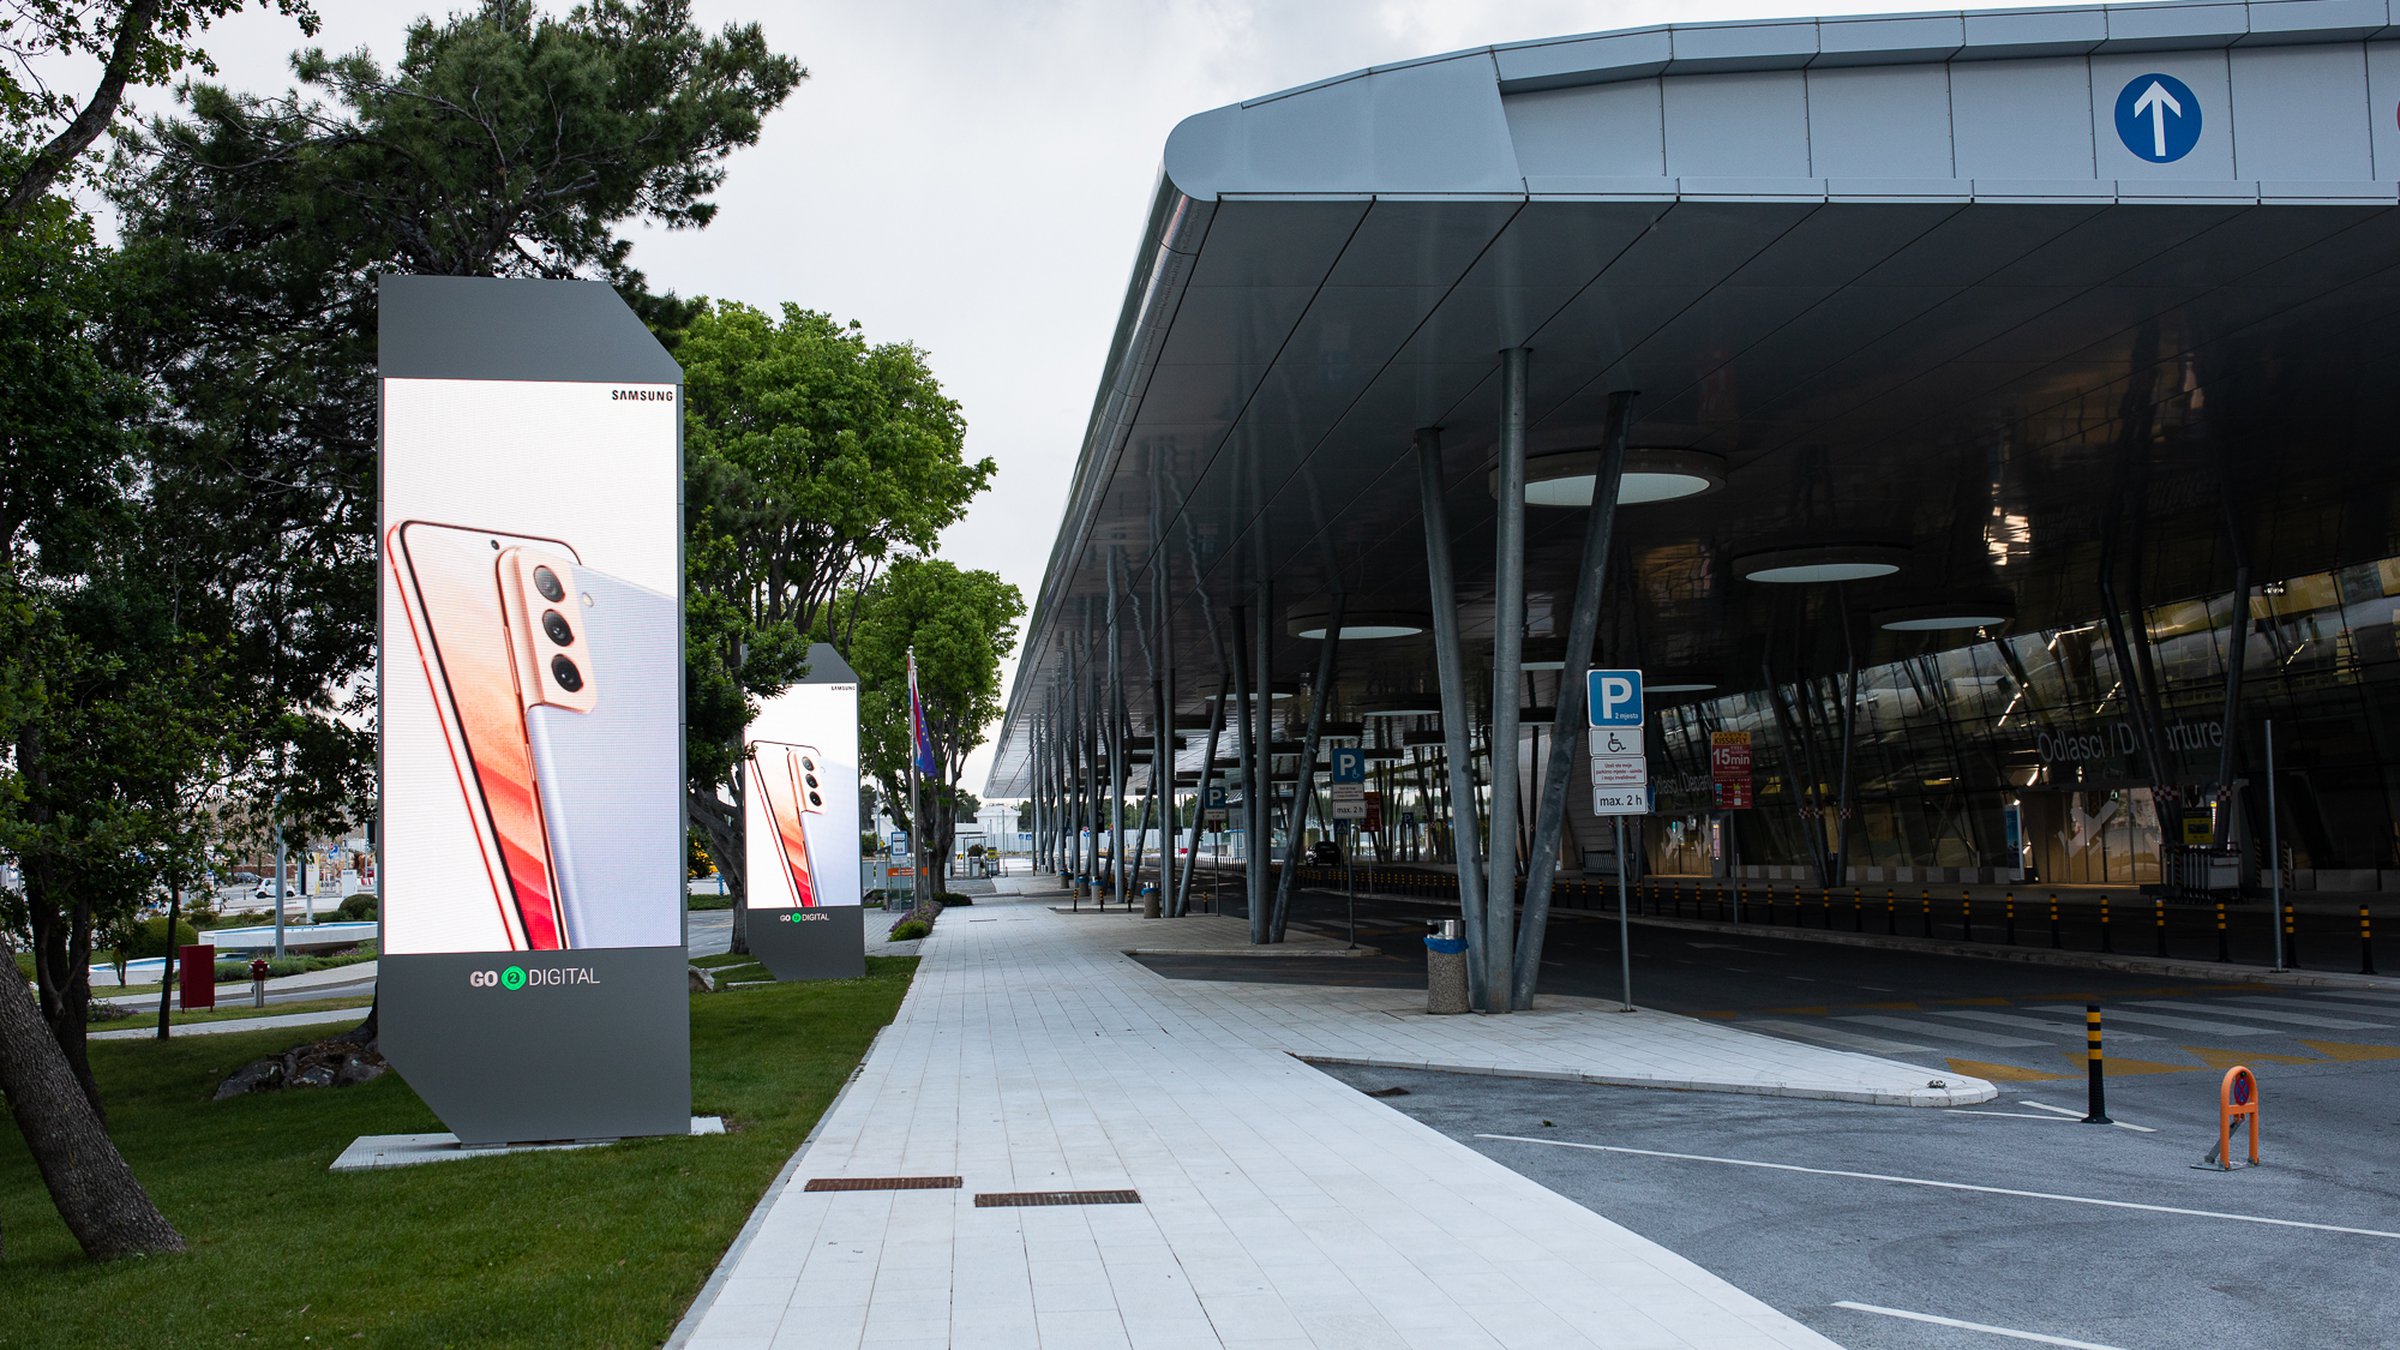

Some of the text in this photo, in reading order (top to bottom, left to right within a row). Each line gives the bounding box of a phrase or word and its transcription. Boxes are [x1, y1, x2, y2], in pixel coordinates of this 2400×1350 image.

[612, 389, 673, 401] SAMSUNG
[1601, 677, 1632, 719] P
[1620, 712, 1639, 720] mjesta
[1714, 737, 1747, 745] KISS&FLY
[2038, 726, 2106, 763] Odlasci
[1340, 754, 1356, 776] P
[1209, 789, 1222, 806] P
[1600, 795, 1642, 806] max. 2 h
